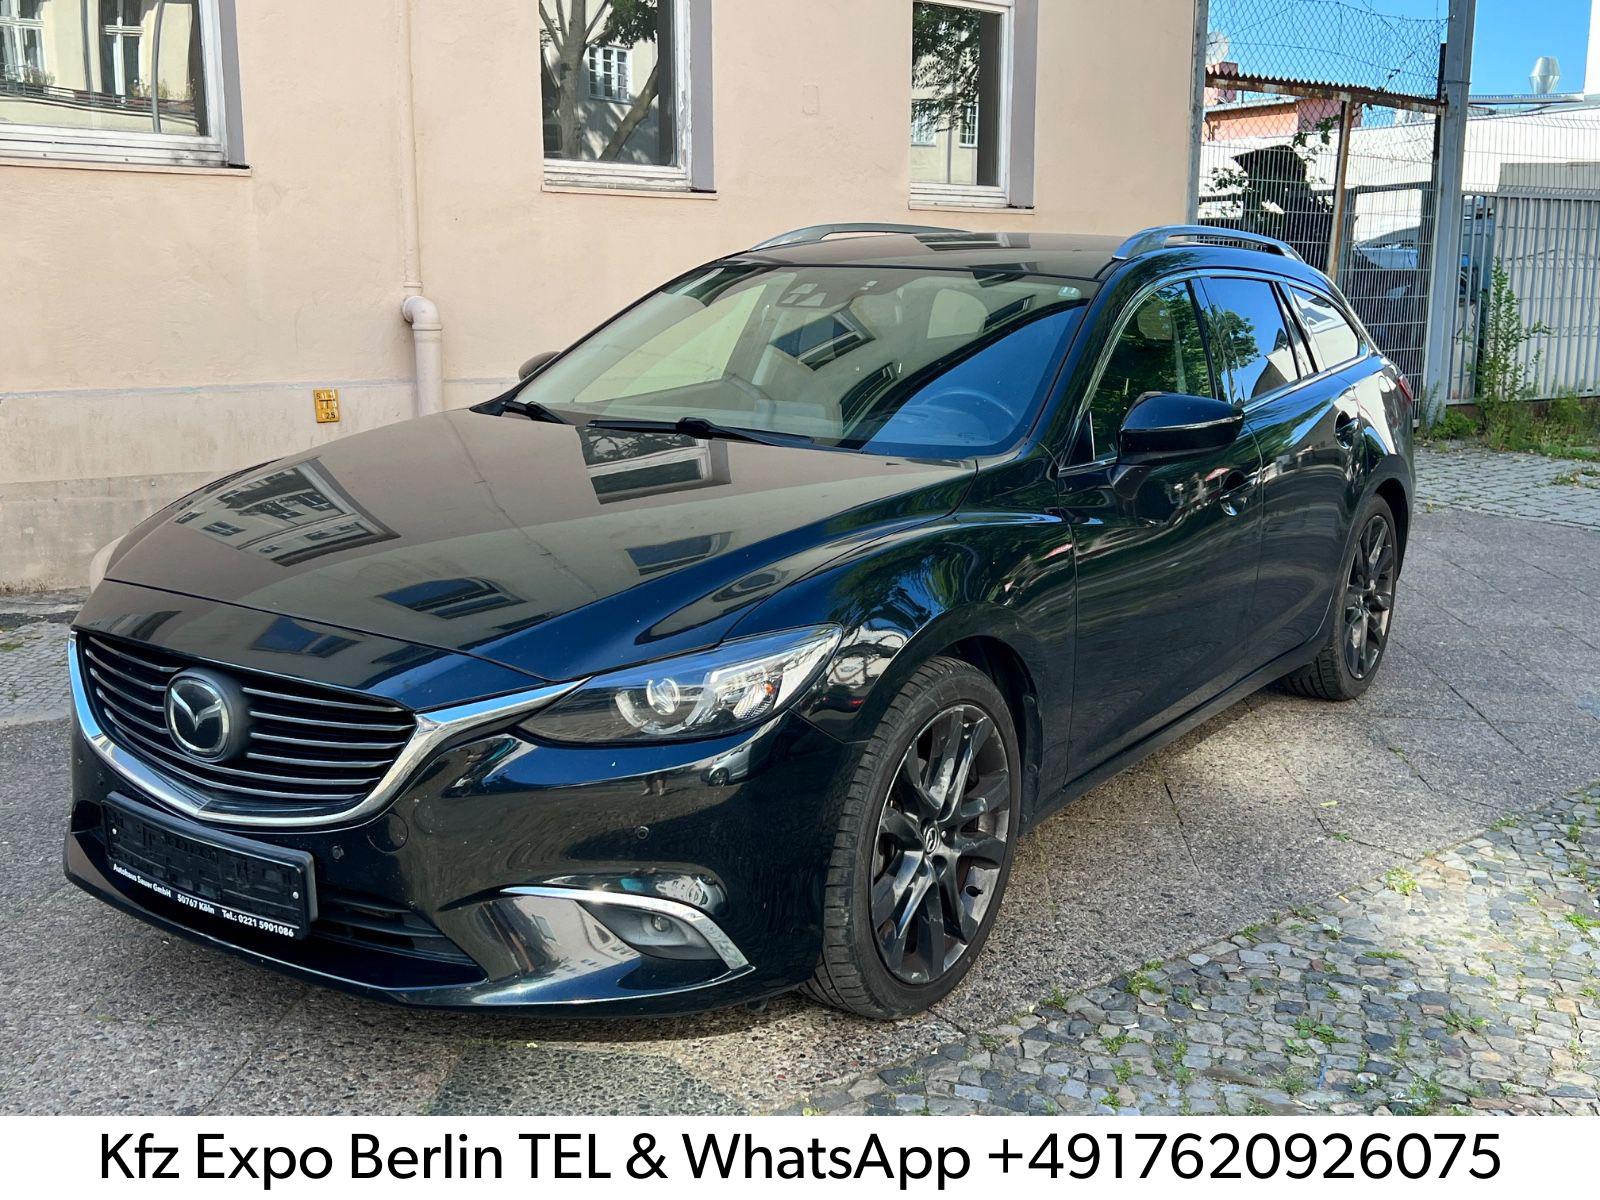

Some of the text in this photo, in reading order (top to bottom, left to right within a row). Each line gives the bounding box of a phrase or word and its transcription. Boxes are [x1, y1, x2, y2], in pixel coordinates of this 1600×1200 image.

[113, 863, 137, 882] Autohaus
[153, 883, 172, 898] GmbH
[177, 894, 198, 908] 50767
[198, 902, 215, 915] Köln
[238, 914, 257, 927] 0221
[258, 920, 294, 937] 5901086
